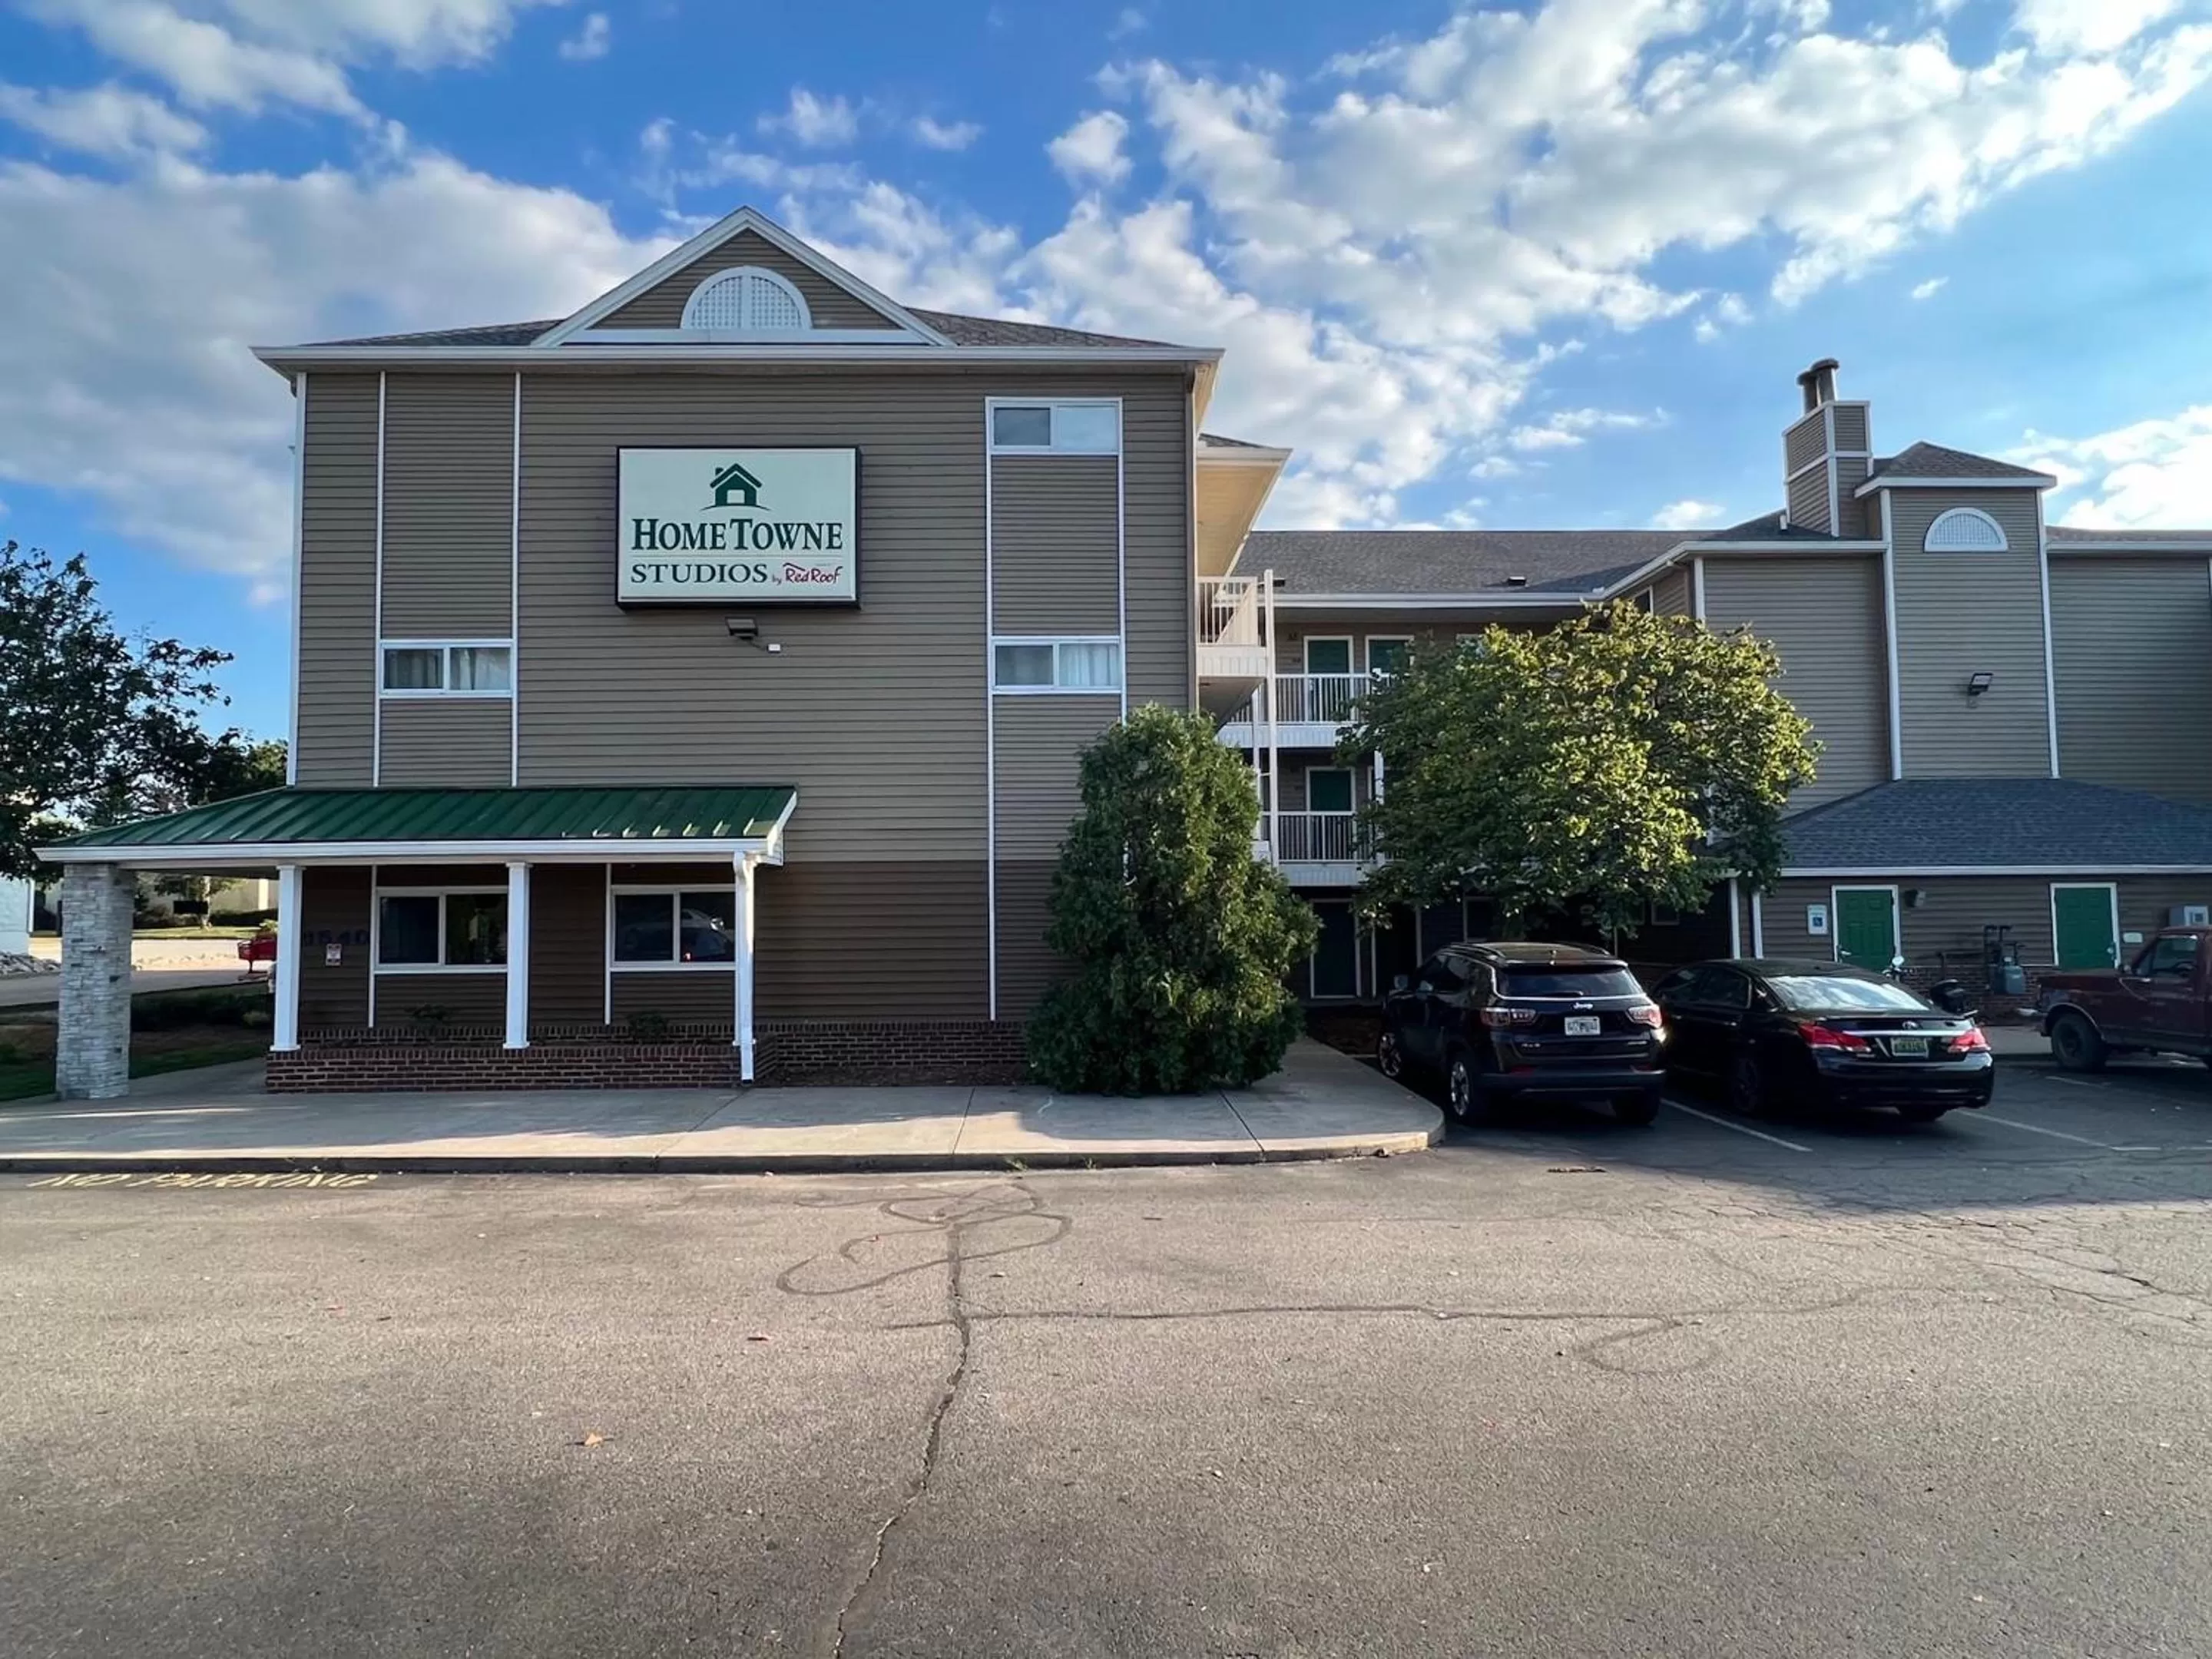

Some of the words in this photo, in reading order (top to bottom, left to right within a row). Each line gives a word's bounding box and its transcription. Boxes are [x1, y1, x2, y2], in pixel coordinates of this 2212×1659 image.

[631, 564, 767, 583] STUDIOS
[771, 574, 782, 585] by
[25, 1173, 132, 1187] NO
[125, 1173, 379, 1188] PARKING
